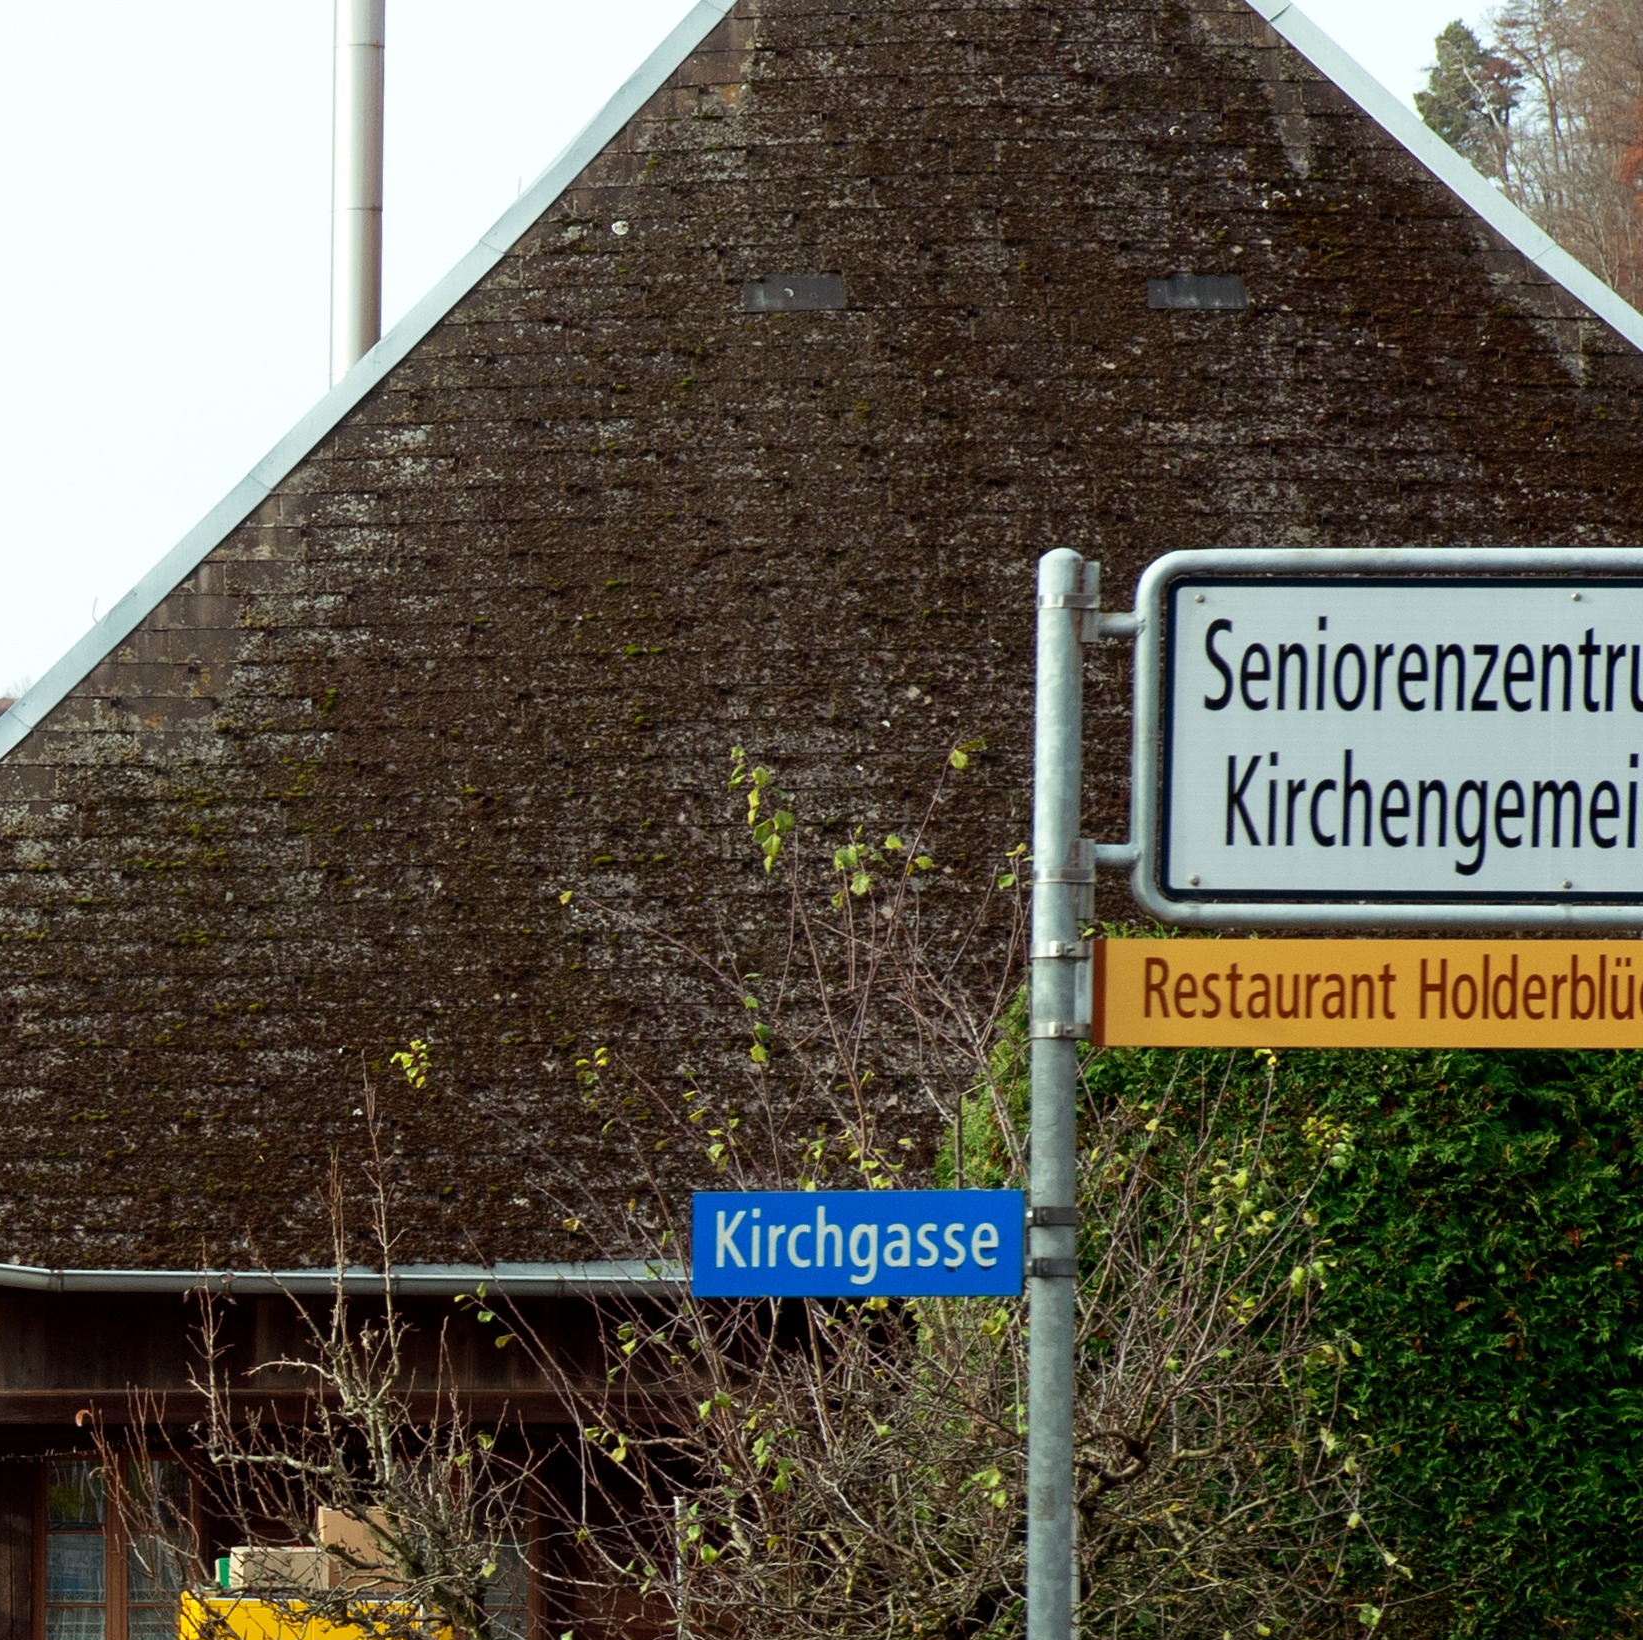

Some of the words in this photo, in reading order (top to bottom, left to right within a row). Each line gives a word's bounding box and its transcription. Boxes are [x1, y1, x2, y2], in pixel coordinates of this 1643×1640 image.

[1224, 748, 1639, 876] Kirchengemei
[1142, 956, 1397, 1020] Restaurant
[1418, 953, 1643, 1020] Holderblü
[715, 1204, 1000, 1286] Kirchgasse
